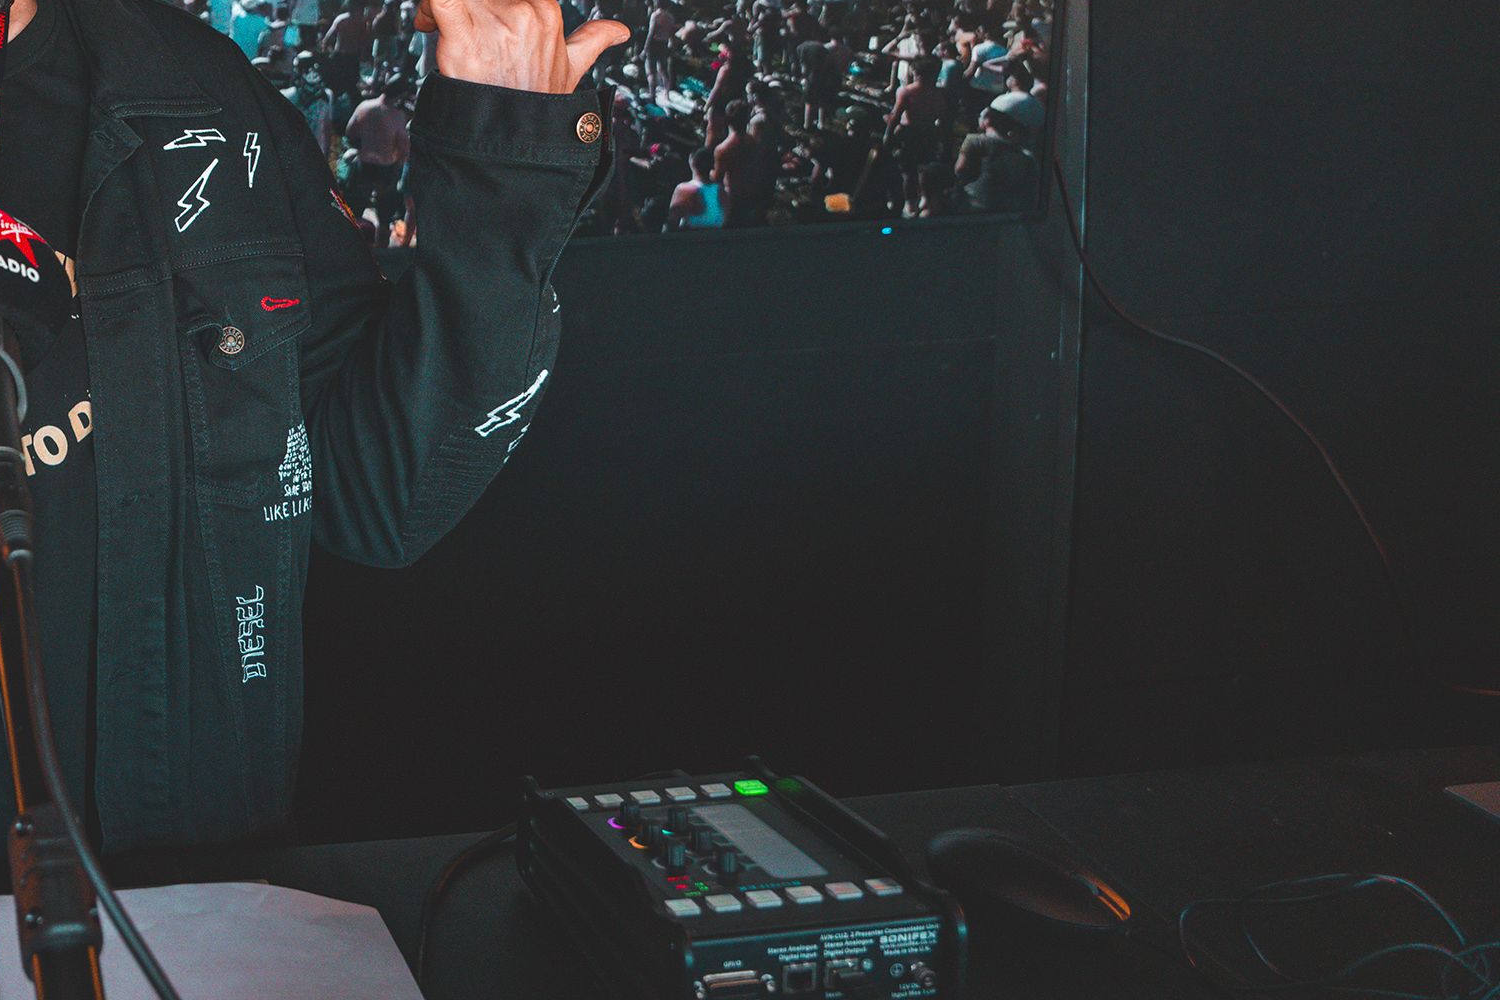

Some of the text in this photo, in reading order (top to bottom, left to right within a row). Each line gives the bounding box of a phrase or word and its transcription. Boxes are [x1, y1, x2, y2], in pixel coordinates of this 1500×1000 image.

[263, 501, 290, 522] LIKE
[236, 584, 268, 684] DIESEL
[880, 930, 936, 944] SONIFEX
[788, 944, 818, 952] Analogue
[823, 949, 843, 957] Digital
